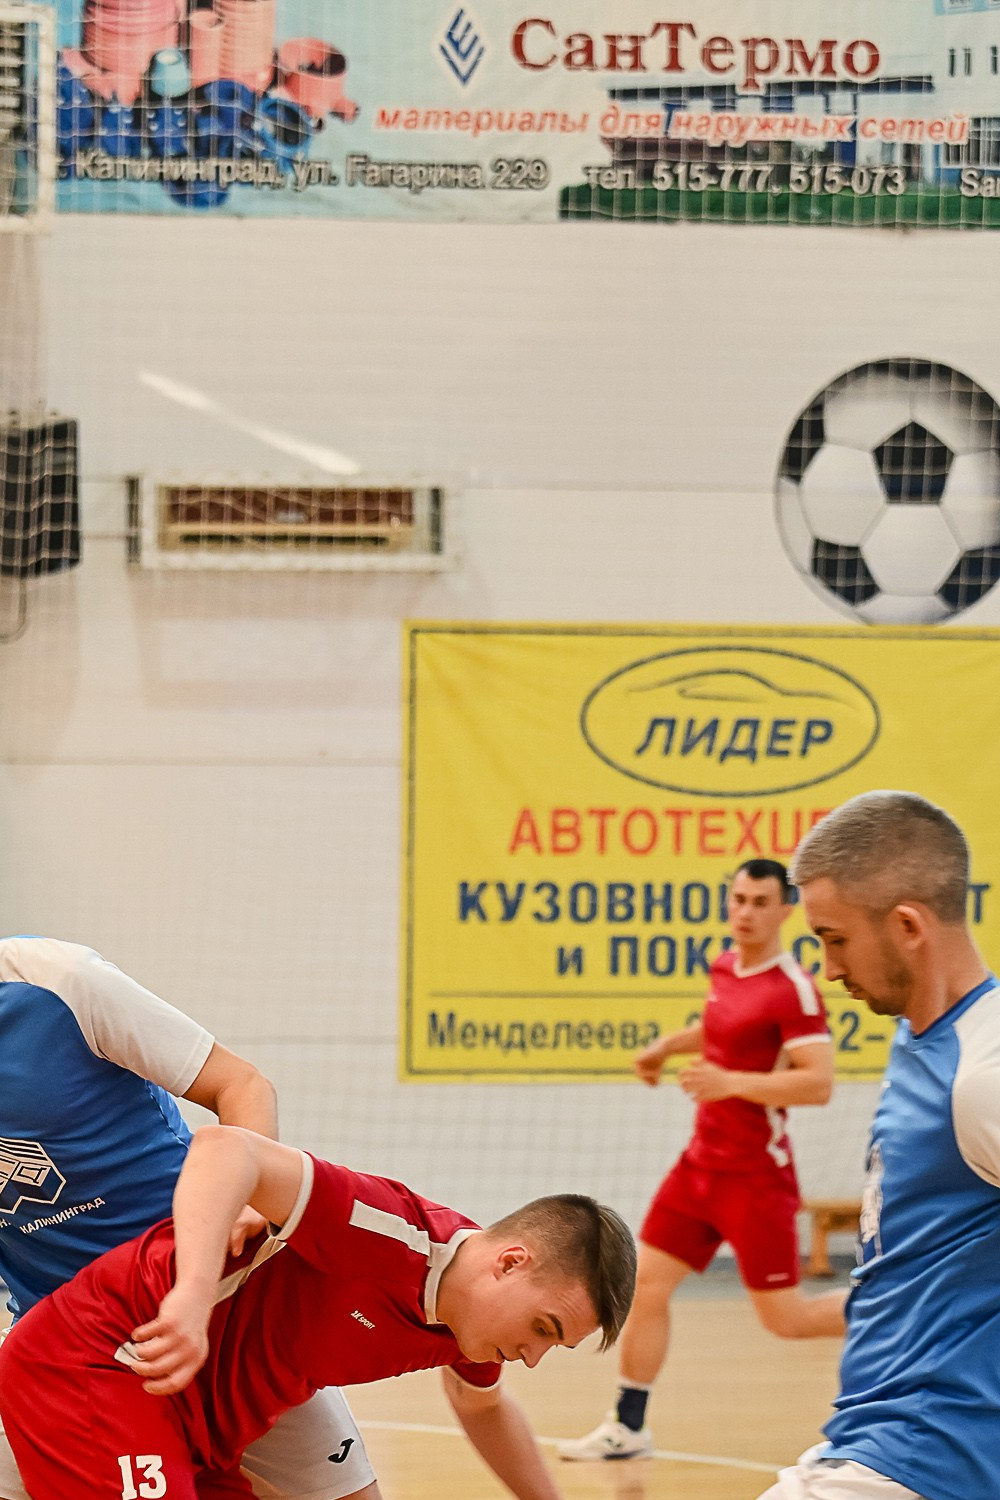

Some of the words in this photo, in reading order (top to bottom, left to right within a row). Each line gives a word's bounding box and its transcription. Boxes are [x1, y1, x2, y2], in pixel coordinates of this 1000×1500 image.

[510, 18, 882, 92] СанТермо
[376, 108, 588, 138] материалы
[600, 105, 663, 135] для
[672, 110, 856, 146] наружных
[860, 113, 968, 143] сетей
[346, 154, 484, 194] Гагарина
[490, 157, 550, 190] 229
[788, 165, 907, 196] 515-073
[635, 717, 834, 764] ЛИДЕР
[555, 945, 583, 977] и
[117, 1454, 167, 1500] 13
